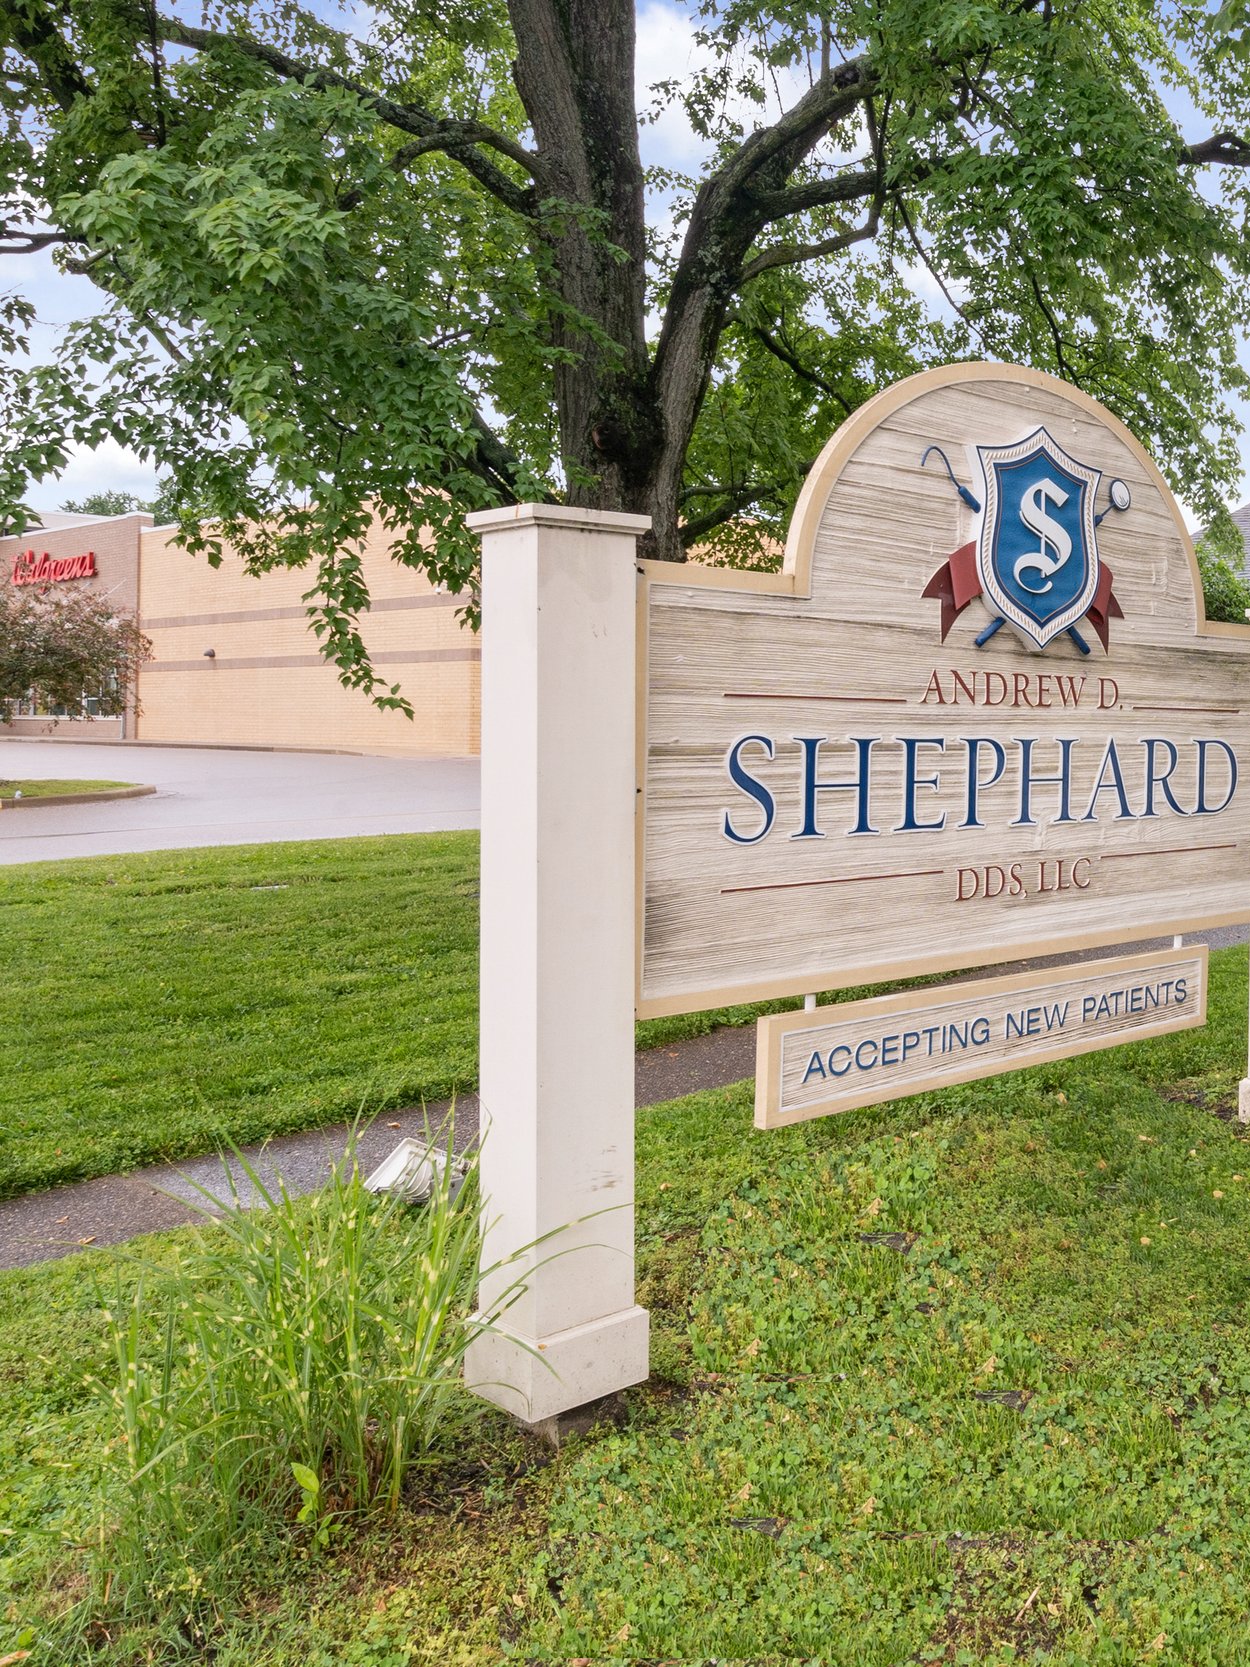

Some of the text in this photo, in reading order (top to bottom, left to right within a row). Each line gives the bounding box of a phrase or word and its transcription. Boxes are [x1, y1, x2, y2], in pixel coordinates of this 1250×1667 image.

[920, 668, 1123, 710] ANDREW D.
[722, 733, 1239, 846] SHEPHARD
[954, 857, 1092, 901] DDS, LLC
[802, 978, 1188, 1084] ACCEPTING NEW PATIENTS
